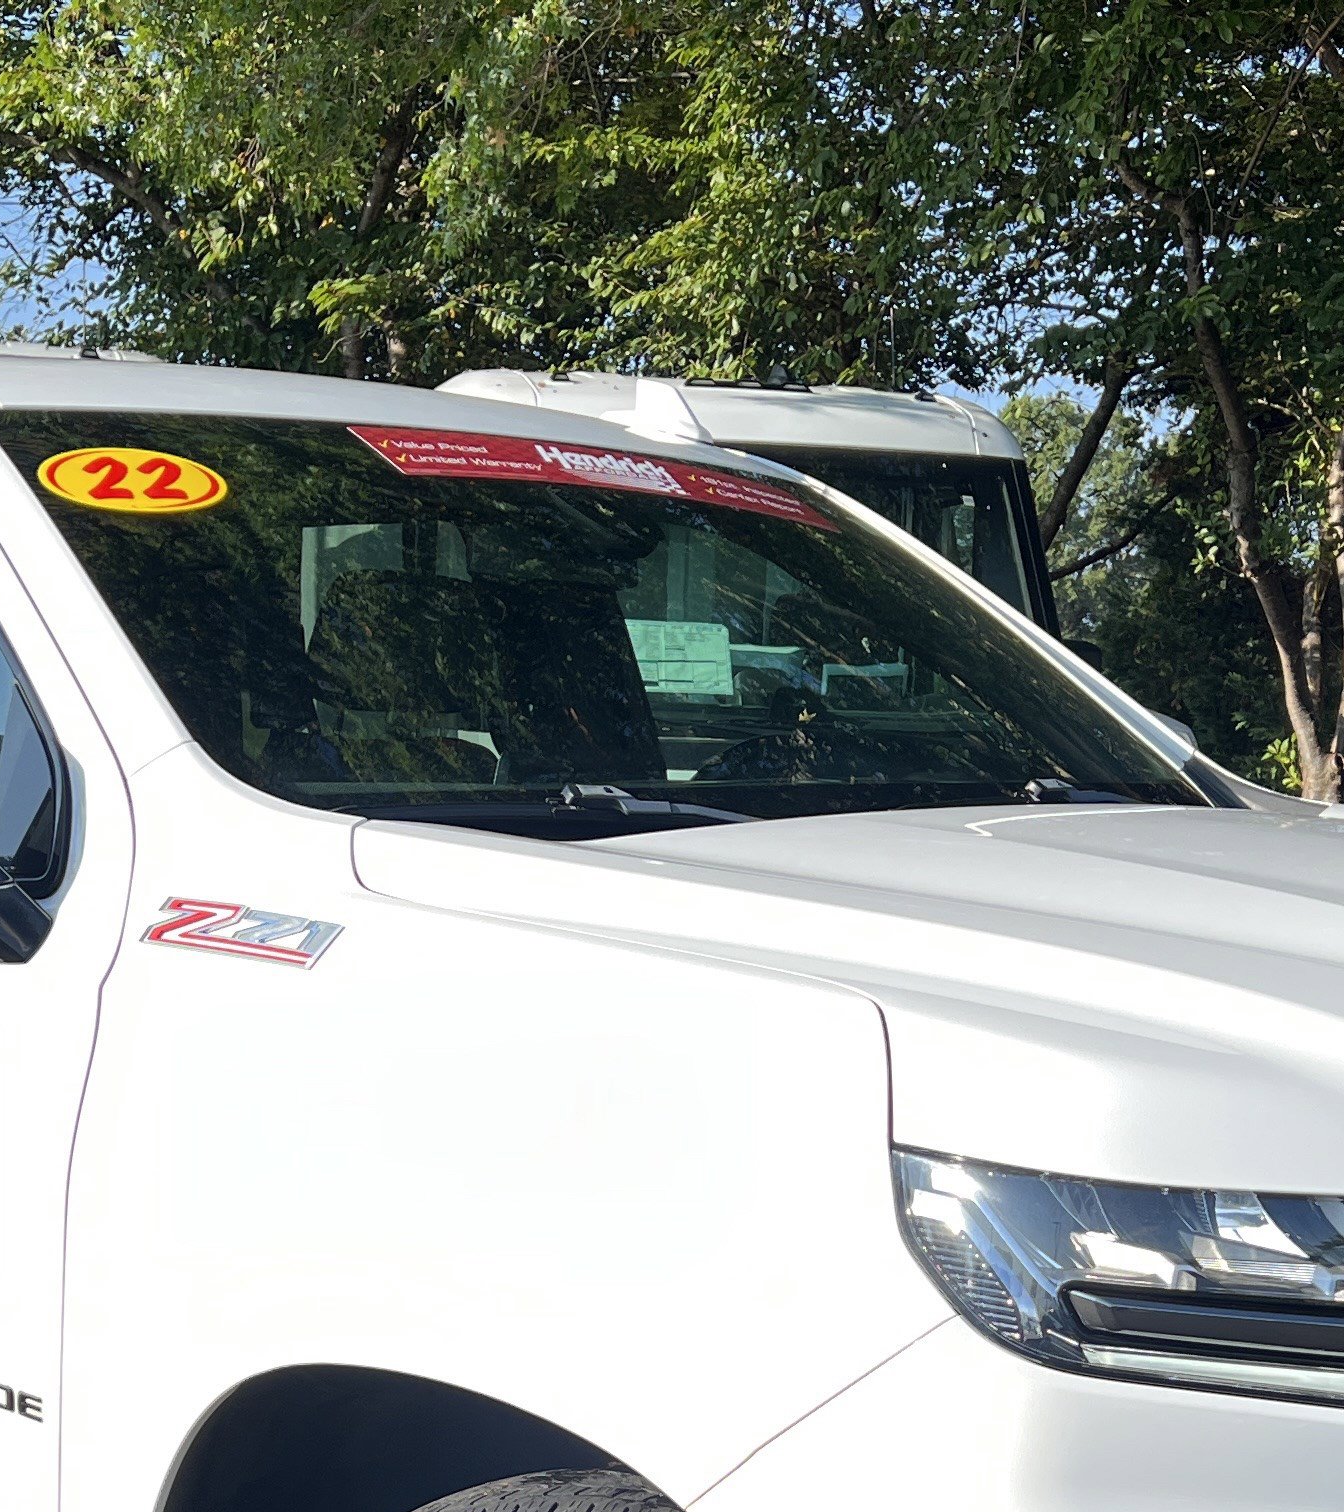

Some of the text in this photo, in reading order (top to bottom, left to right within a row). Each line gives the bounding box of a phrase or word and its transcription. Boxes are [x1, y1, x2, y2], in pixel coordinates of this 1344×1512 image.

[390, 439, 488, 453] Value Priced
[409, 454, 542, 471] Limited Warranty
[535, 444, 668, 482] Hendrick
[82, 456, 189, 500] 22
[139, 896, 346, 971] Z71
